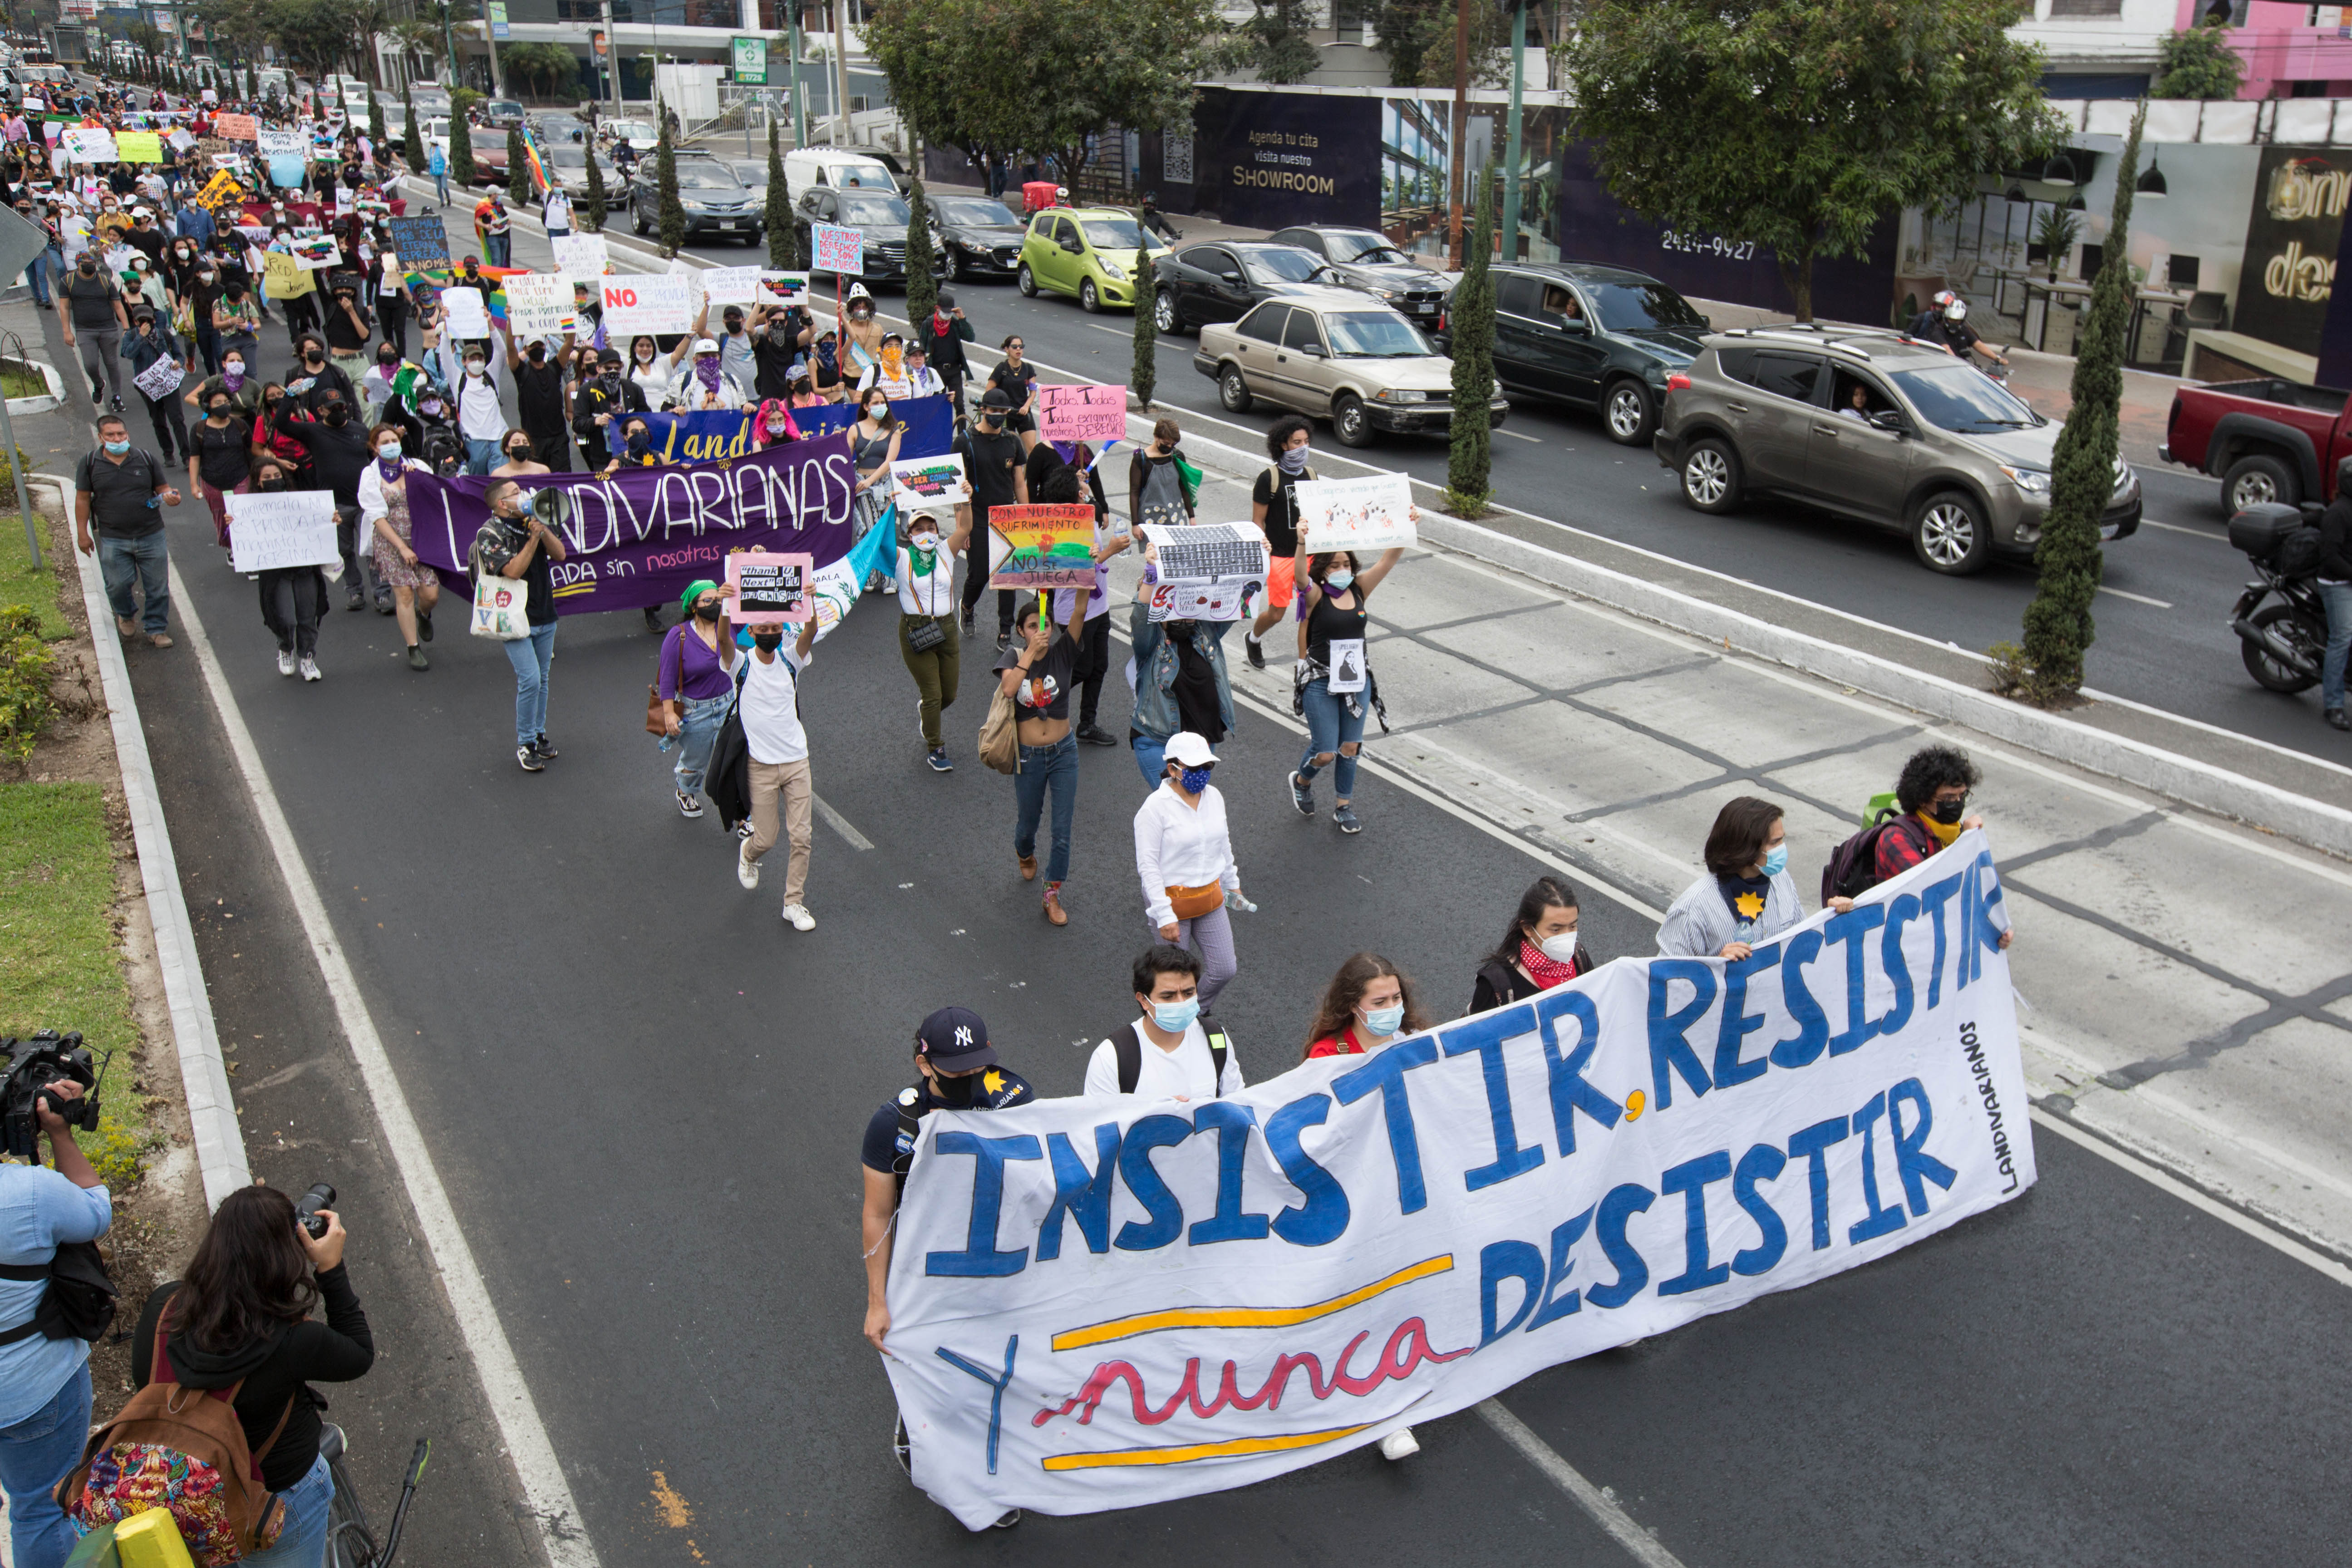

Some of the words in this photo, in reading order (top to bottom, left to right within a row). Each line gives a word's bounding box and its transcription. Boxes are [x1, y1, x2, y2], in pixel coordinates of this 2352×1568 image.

[1248, 130, 1283, 146] Agenda
[1285, 132, 1296, 145] tu
[1299, 133, 1319, 147] cita
[1255, 150, 1279, 163] visita
[1280, 154, 1312, 166] nuestro
[392, 218, 442, 231] GUATEMALA
[433, 228, 445, 240] LA
[818, 227, 861, 243] NUESTROS
[402, 240, 439, 251] ETERNA
[819, 240, 859, 253] DERECHOS
[819, 248, 832, 258] NO
[837, 249, 854, 261] SON
[269, 256, 292, 277] RED
[819, 259, 832, 267] UN
[615, 275, 675, 288] GUATEMALA
[605, 287, 638, 309] NO
[515, 308, 535, 317] PARA
[538, 305, 574, 315] PROMOVER
[539, 318, 559, 329] ODIO
[1076, 386, 1117, 405] Todas
[1042, 406, 1073, 425] Todos
[1078, 412, 1122, 425] exigimos
[1041, 425, 1077, 437] nuestros
[1075, 423, 1126, 438] DERECHOS
[921, 464, 955, 475] LIBERTAD
[901, 477, 912, 486] DE
[913, 475, 928, 485] SER
[929, 472, 950, 482] COMO
[914, 482, 940, 492] SOMOS
[1317, 486, 1346, 498] Congreso
[1370, 484, 1379, 493] que
[1380, 481, 1398, 490] Guate
[231, 496, 301, 520] Guatemala
[309, 494, 328, 510] NO
[441, 454, 851, 572] LNDIVARIANAS
[990, 507, 1017, 521] CON
[1027, 506, 1086, 517] NUESTRO
[251, 515, 309, 535] PROVIDA
[1001, 520, 1081, 533] SUFRIMIENTO
[235, 533, 297, 552] machista
[254, 548, 317, 568] ASESINA
[1011, 553, 1038, 571] NO
[550, 561, 597, 588] ADA
[607, 558, 635, 578] sin
[646, 545, 720, 572] nosotras
[1023, 570, 1078, 584] JUEGA
[1210, 600, 1222, 609] NO
[1647, 849, 2004, 1111] RESISTIR
[1959, 1021, 2018, 1195] LANDIVARIANOS
[1476, 1076, 1958, 1351] DESISTIR
[935, 1334, 1019, 1474] Y
[1032, 1315, 1476, 1428] nunca
